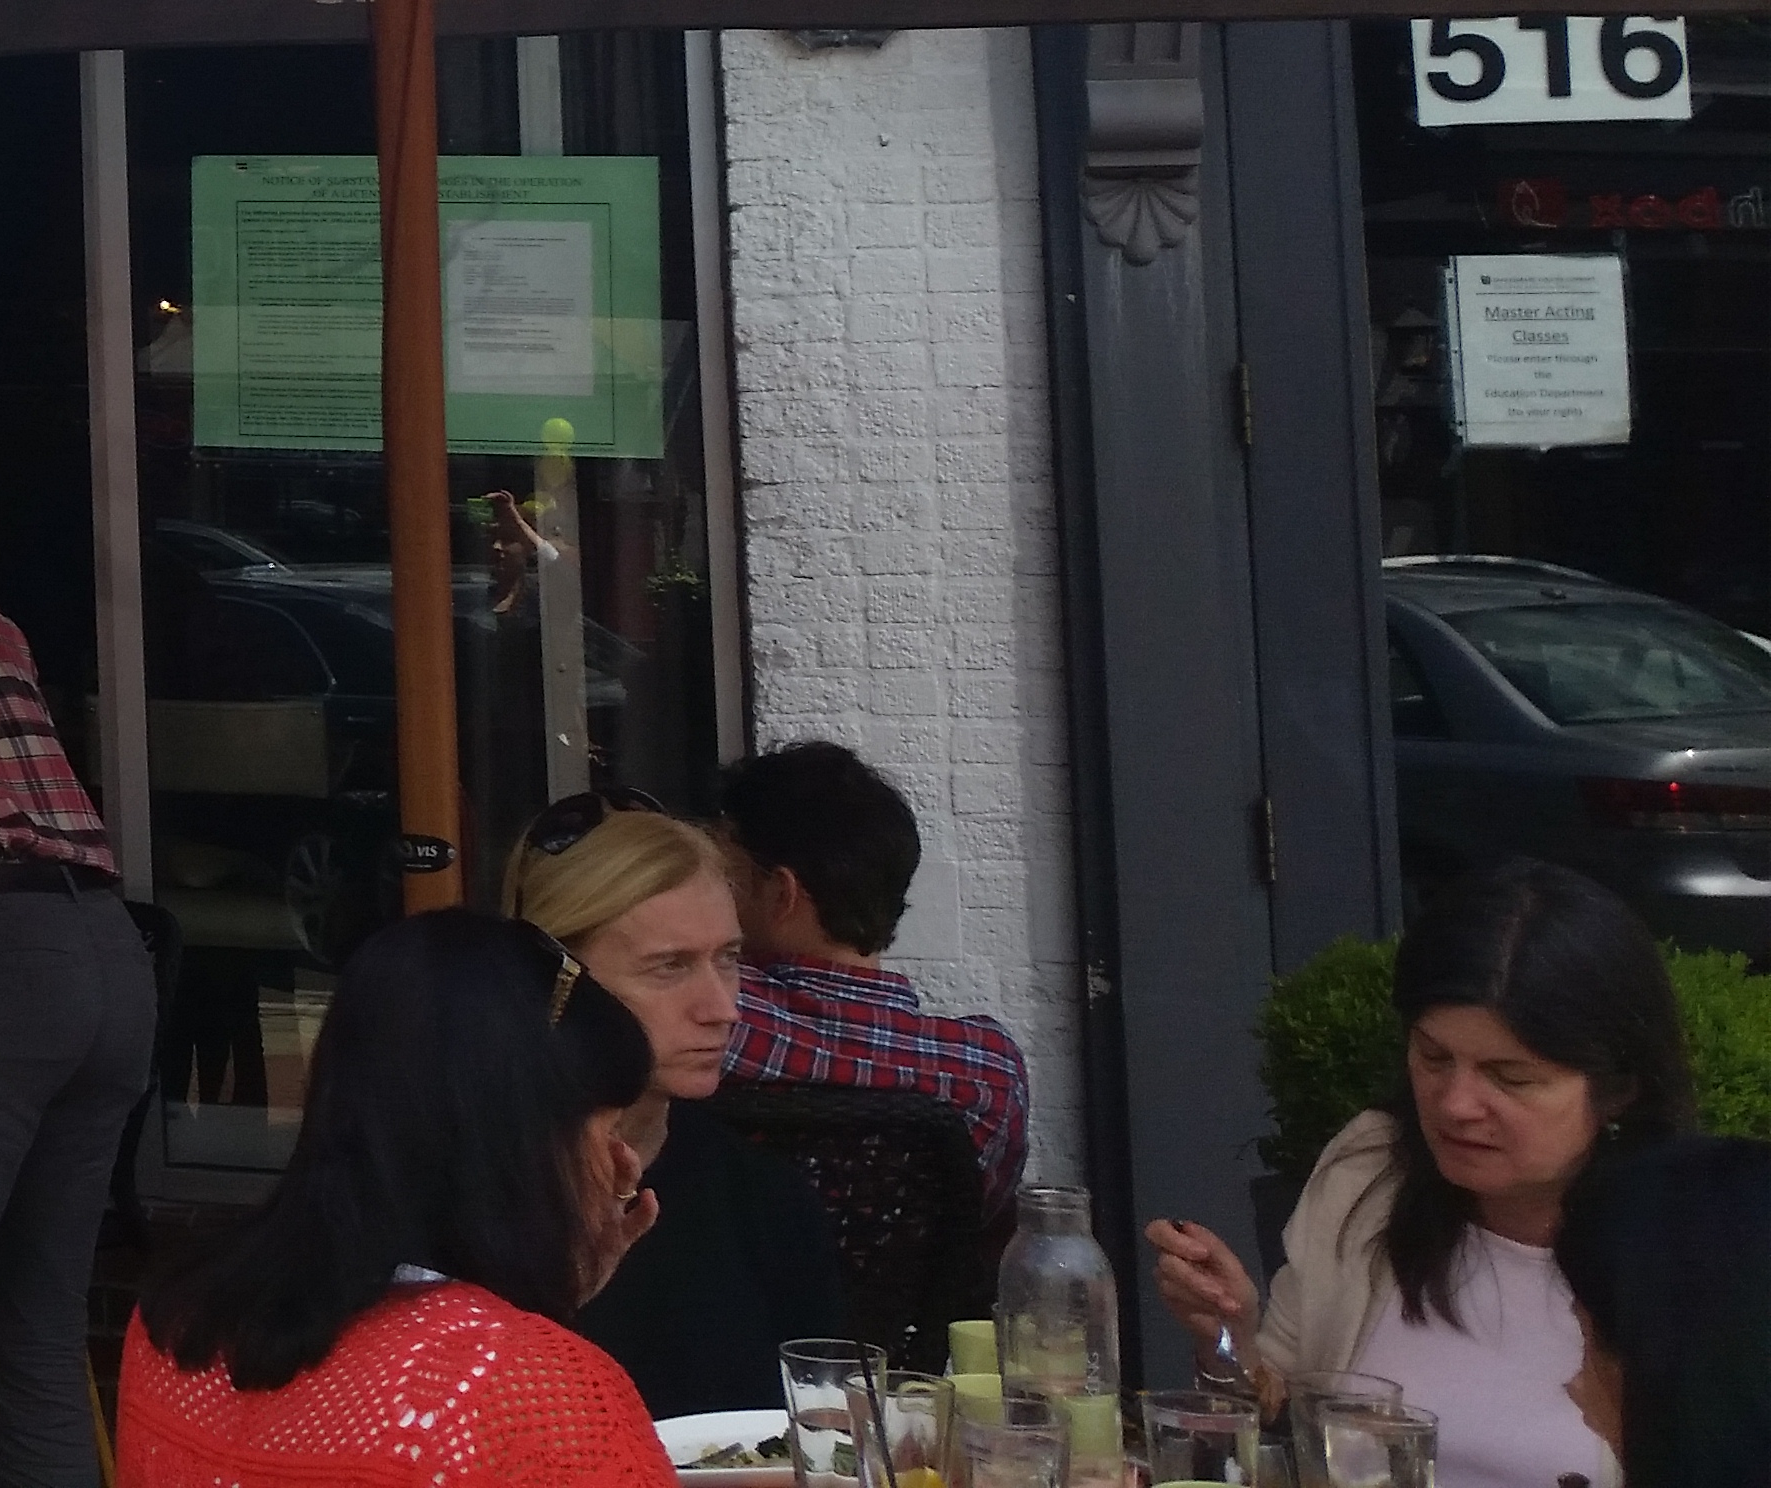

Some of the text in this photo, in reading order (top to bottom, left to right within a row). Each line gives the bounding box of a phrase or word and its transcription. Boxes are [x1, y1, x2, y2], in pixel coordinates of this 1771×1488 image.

[1425, 17, 1683, 102] 516
[262, 176, 305, 186] NOTICE
[308, 176, 322, 186] OF
[327, 176, 378, 187] SUBSTAN
[489, 176, 511, 187] THE
[513, 177, 583, 188] OPERATION
[312, 189, 327, 199] OF
[342, 190, 378, 199] LICEN
[437, 189, 530, 200] STABLISHMENT
[1484, 306, 1595, 321] Master Acting
[1512, 330, 1569, 344] Classes
[1486, 354, 1598, 365] Please enter through
[1533, 371, 1552, 379] the
[1484, 388, 1604, 399] Education Department
